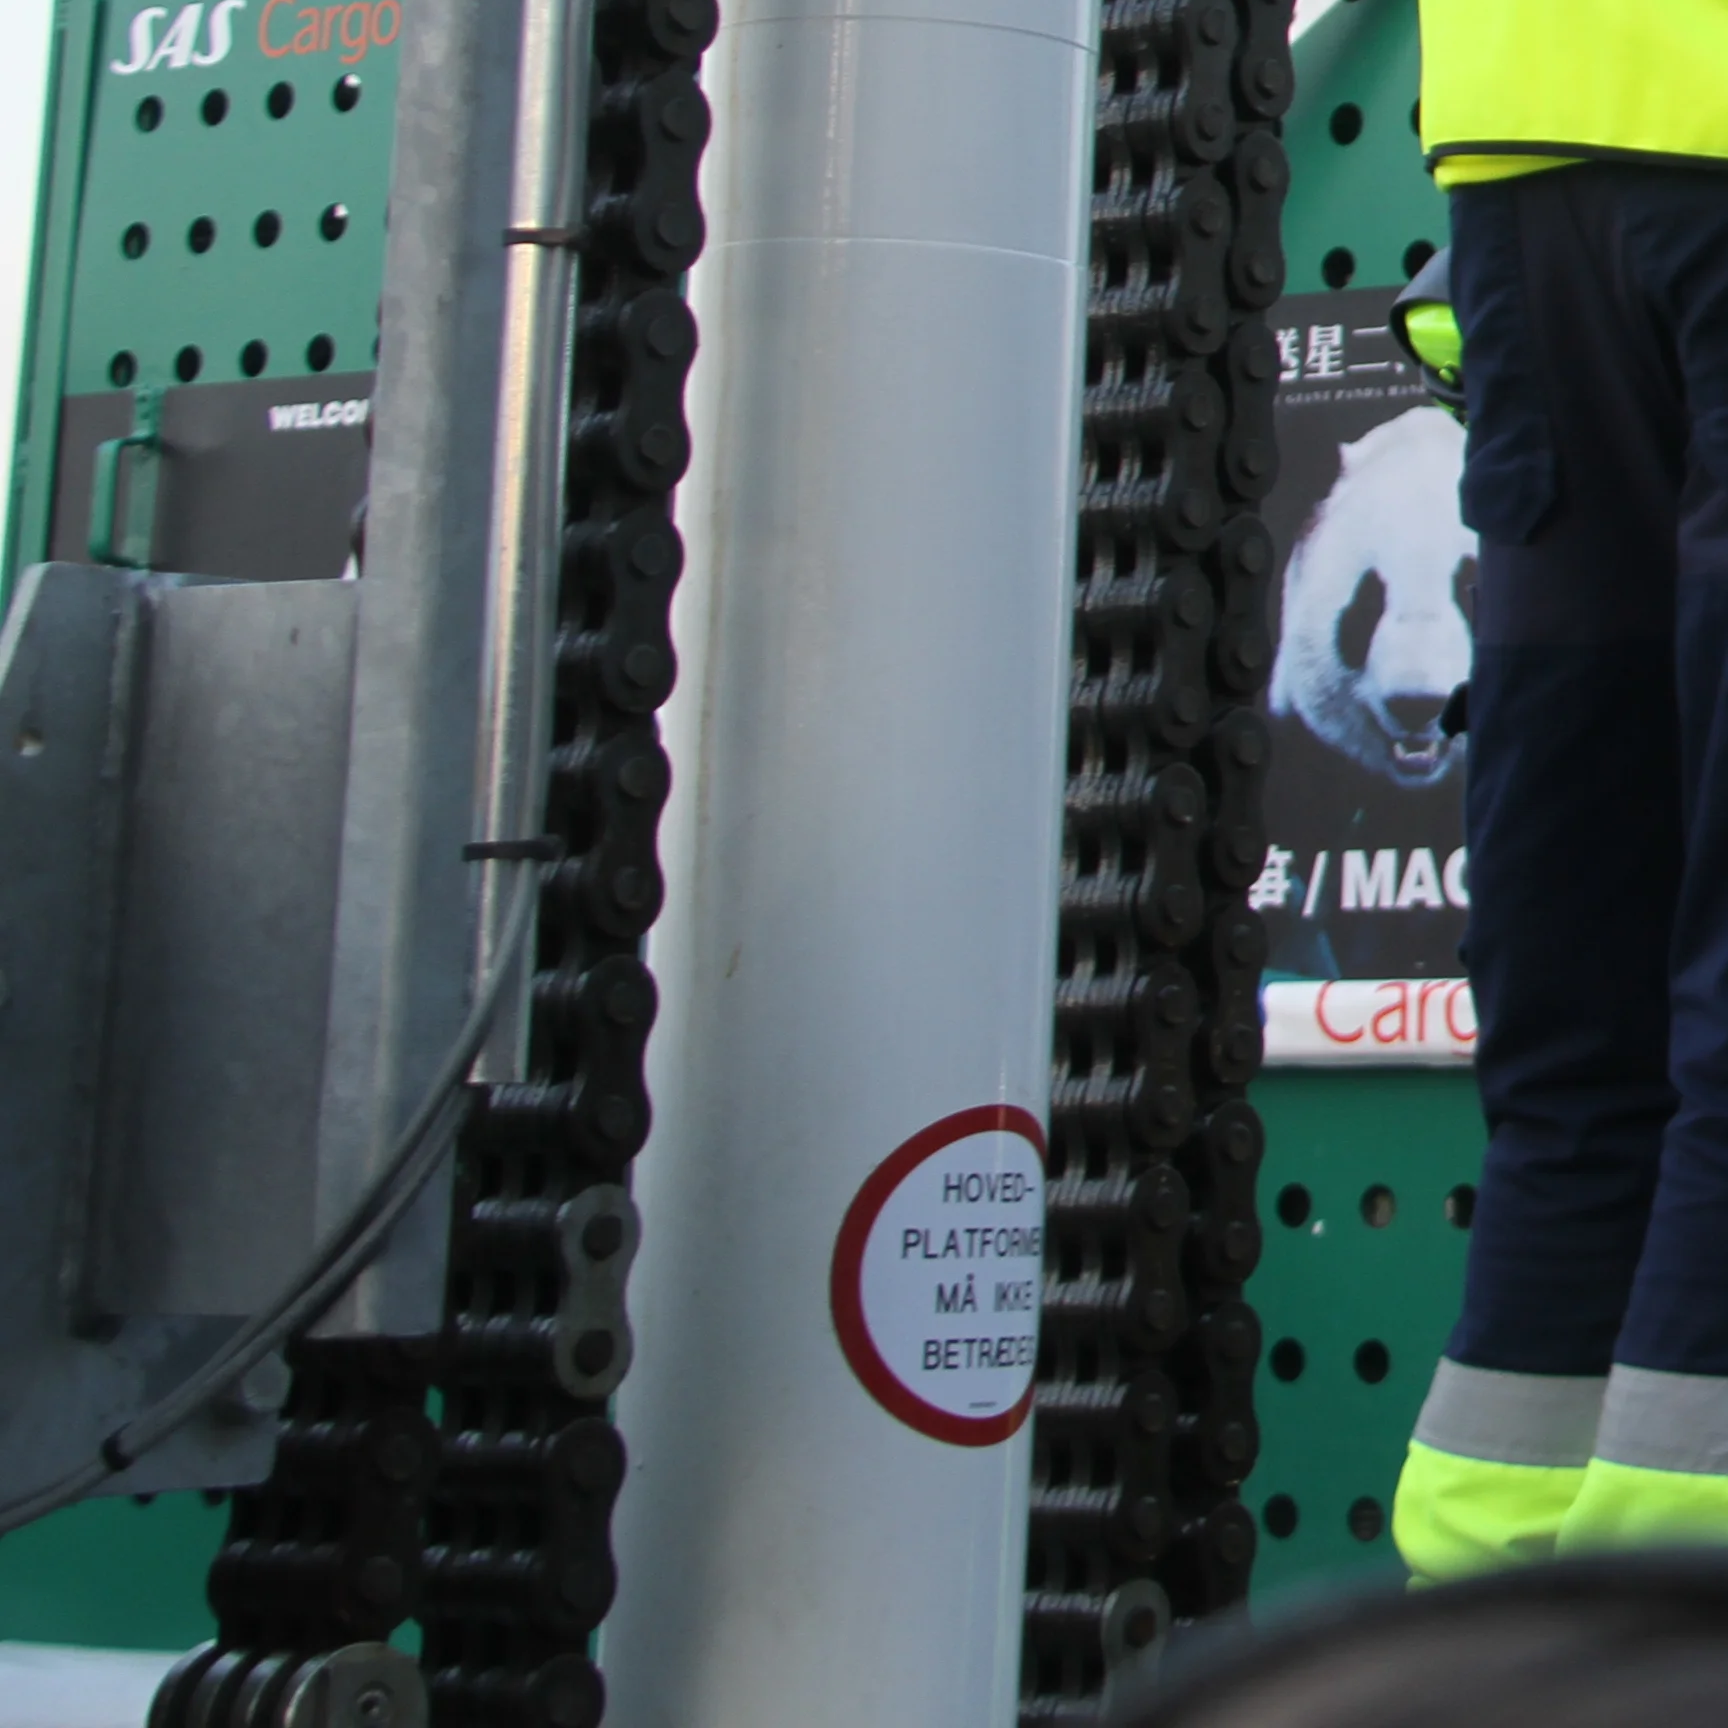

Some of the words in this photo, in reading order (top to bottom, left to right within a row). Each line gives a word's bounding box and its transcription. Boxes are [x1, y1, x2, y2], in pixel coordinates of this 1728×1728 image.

[1315, 980, 1478, 1058] Carg
[943, 1172, 1035, 1203] HOVED-
[935, 1273, 977, 1313] MÅ
[994, 1280, 1033, 1312] IKKE
